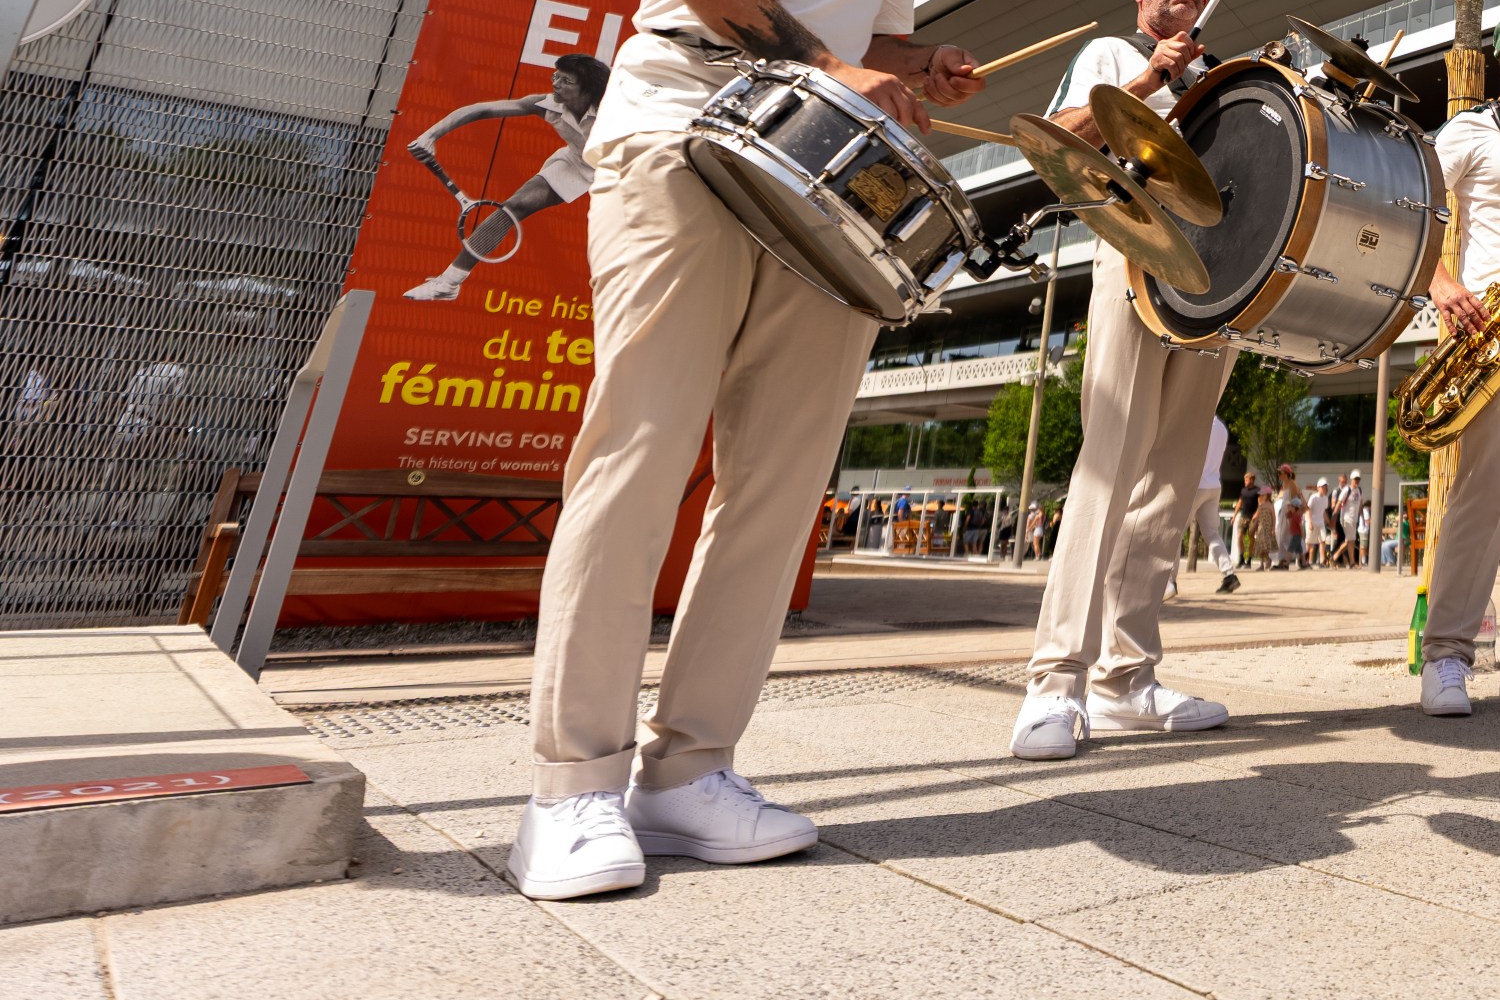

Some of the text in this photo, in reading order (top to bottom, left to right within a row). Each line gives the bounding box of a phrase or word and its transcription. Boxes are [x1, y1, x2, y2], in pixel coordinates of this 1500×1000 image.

[484, 289, 542, 316] Une
[482, 329, 531, 362] du
[379, 361, 581, 412] féminin
[404, 427, 512, 448] SERVING
[519, 433, 564, 450] FOR
[398, 456, 559, 472] The history of women's
[2, 774, 232, 805] (2021)
